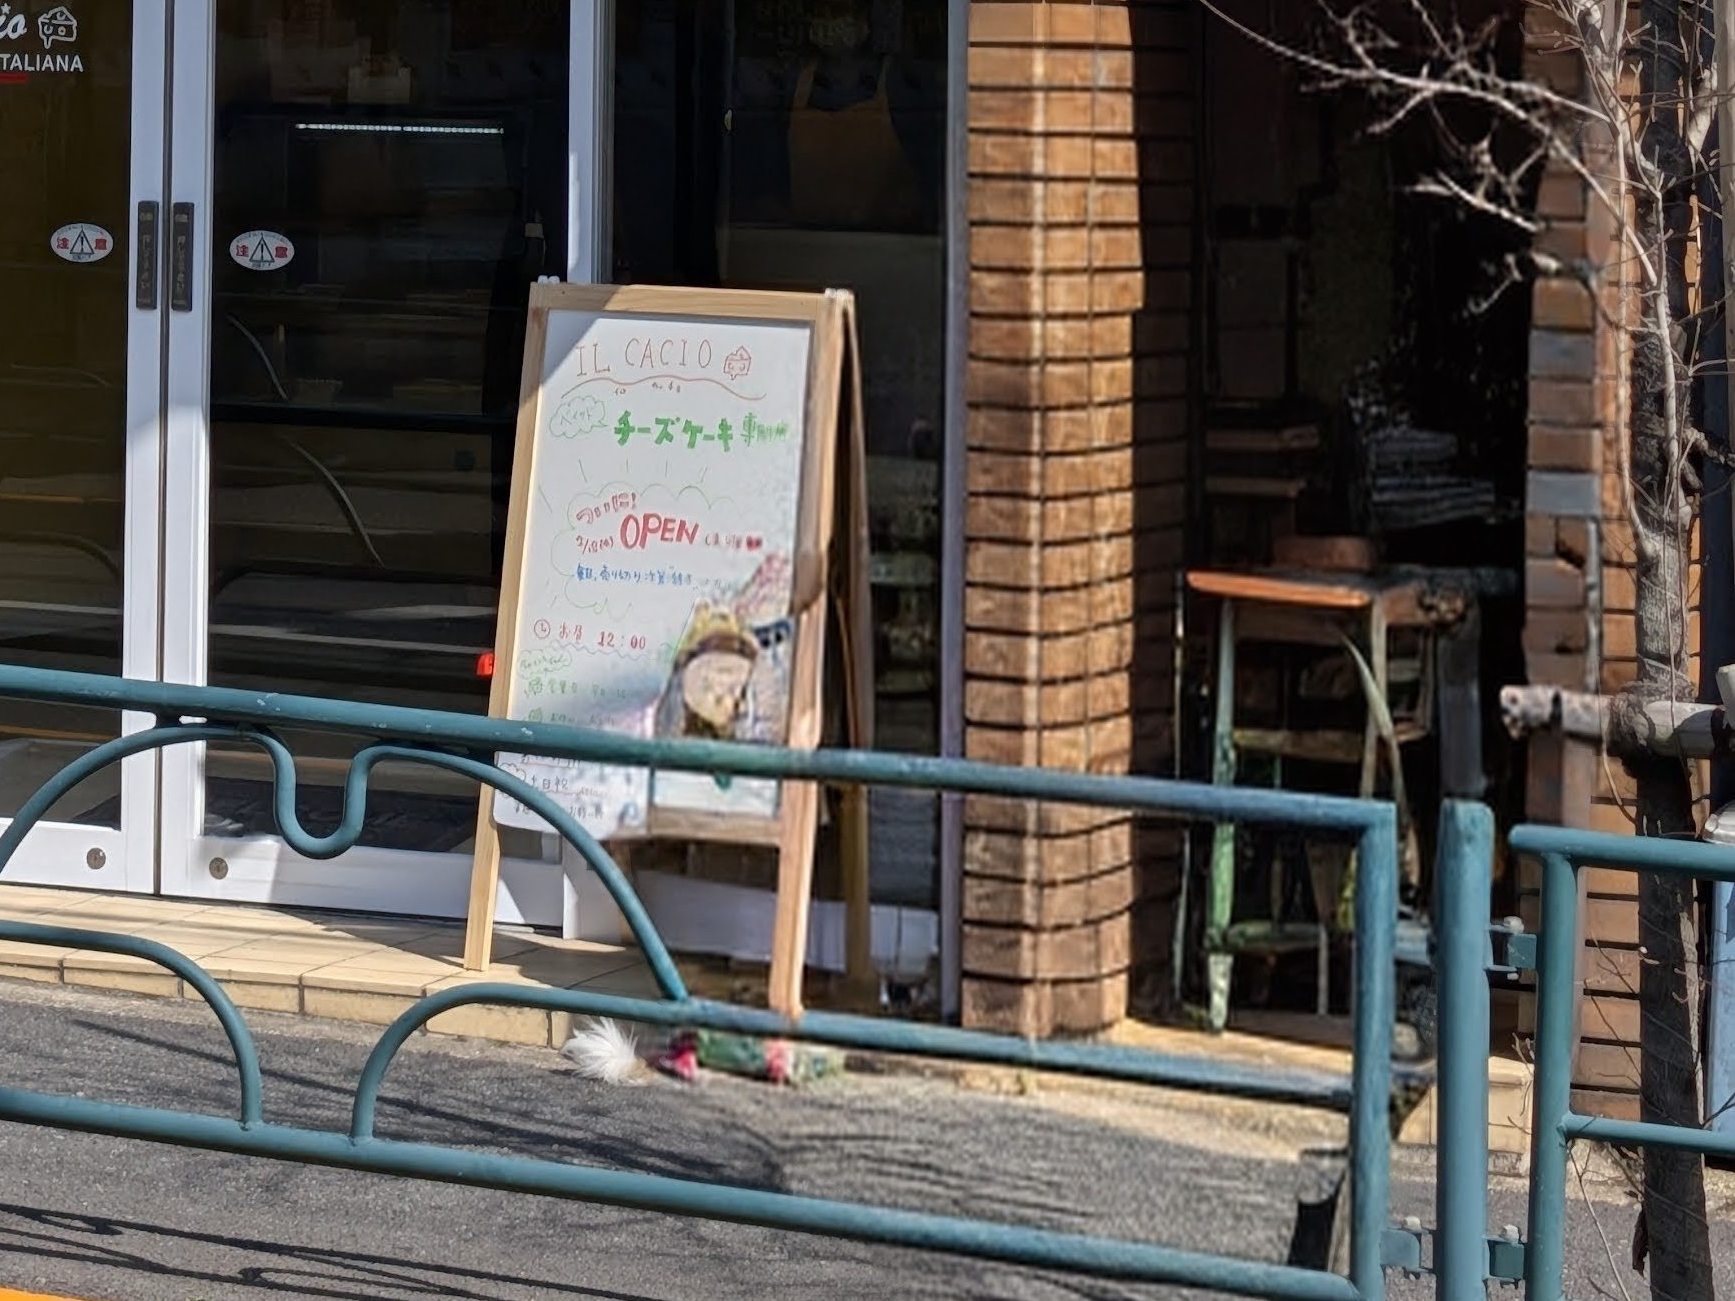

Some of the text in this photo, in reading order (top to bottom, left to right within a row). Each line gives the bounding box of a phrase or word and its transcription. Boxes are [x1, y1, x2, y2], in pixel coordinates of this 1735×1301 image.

[576, 337, 712, 376] IL CACIO
[619, 512, 700, 550] OPEN
[597, 630, 647, 650] 12:00
